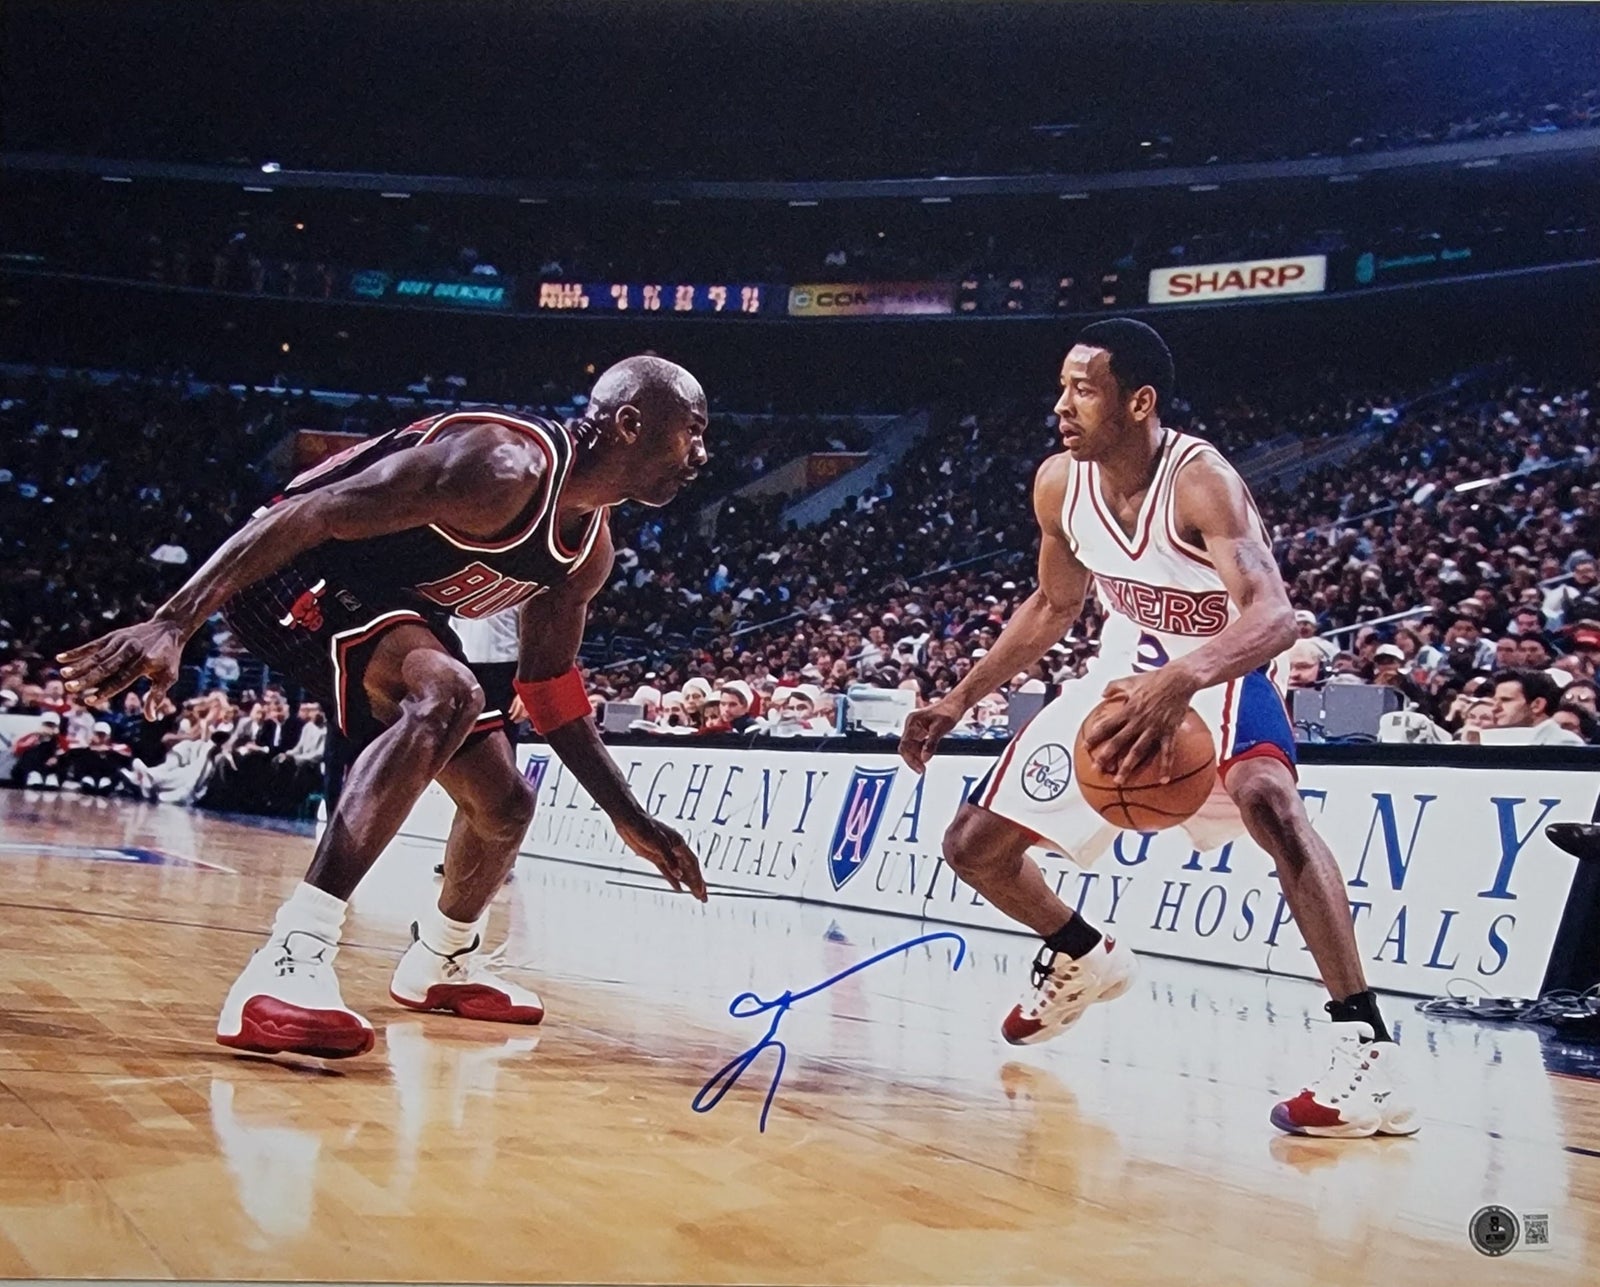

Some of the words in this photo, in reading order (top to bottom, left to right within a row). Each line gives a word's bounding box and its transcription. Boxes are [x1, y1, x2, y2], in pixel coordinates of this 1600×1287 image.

[1168, 263, 1306, 297] SHARP
[415, 561, 550, 620] BUL
[1095, 572, 1229, 637] XERS
[541, 762, 829, 833] ALGHENY
[528, 812, 628, 855] UNIVERSI
[683, 827, 803, 881] SPITALS
[888, 772, 1562, 900] ALGNY
[876, 851, 1133, 924] UNIITY
[1150, 880, 1517, 976] HOSPALS
